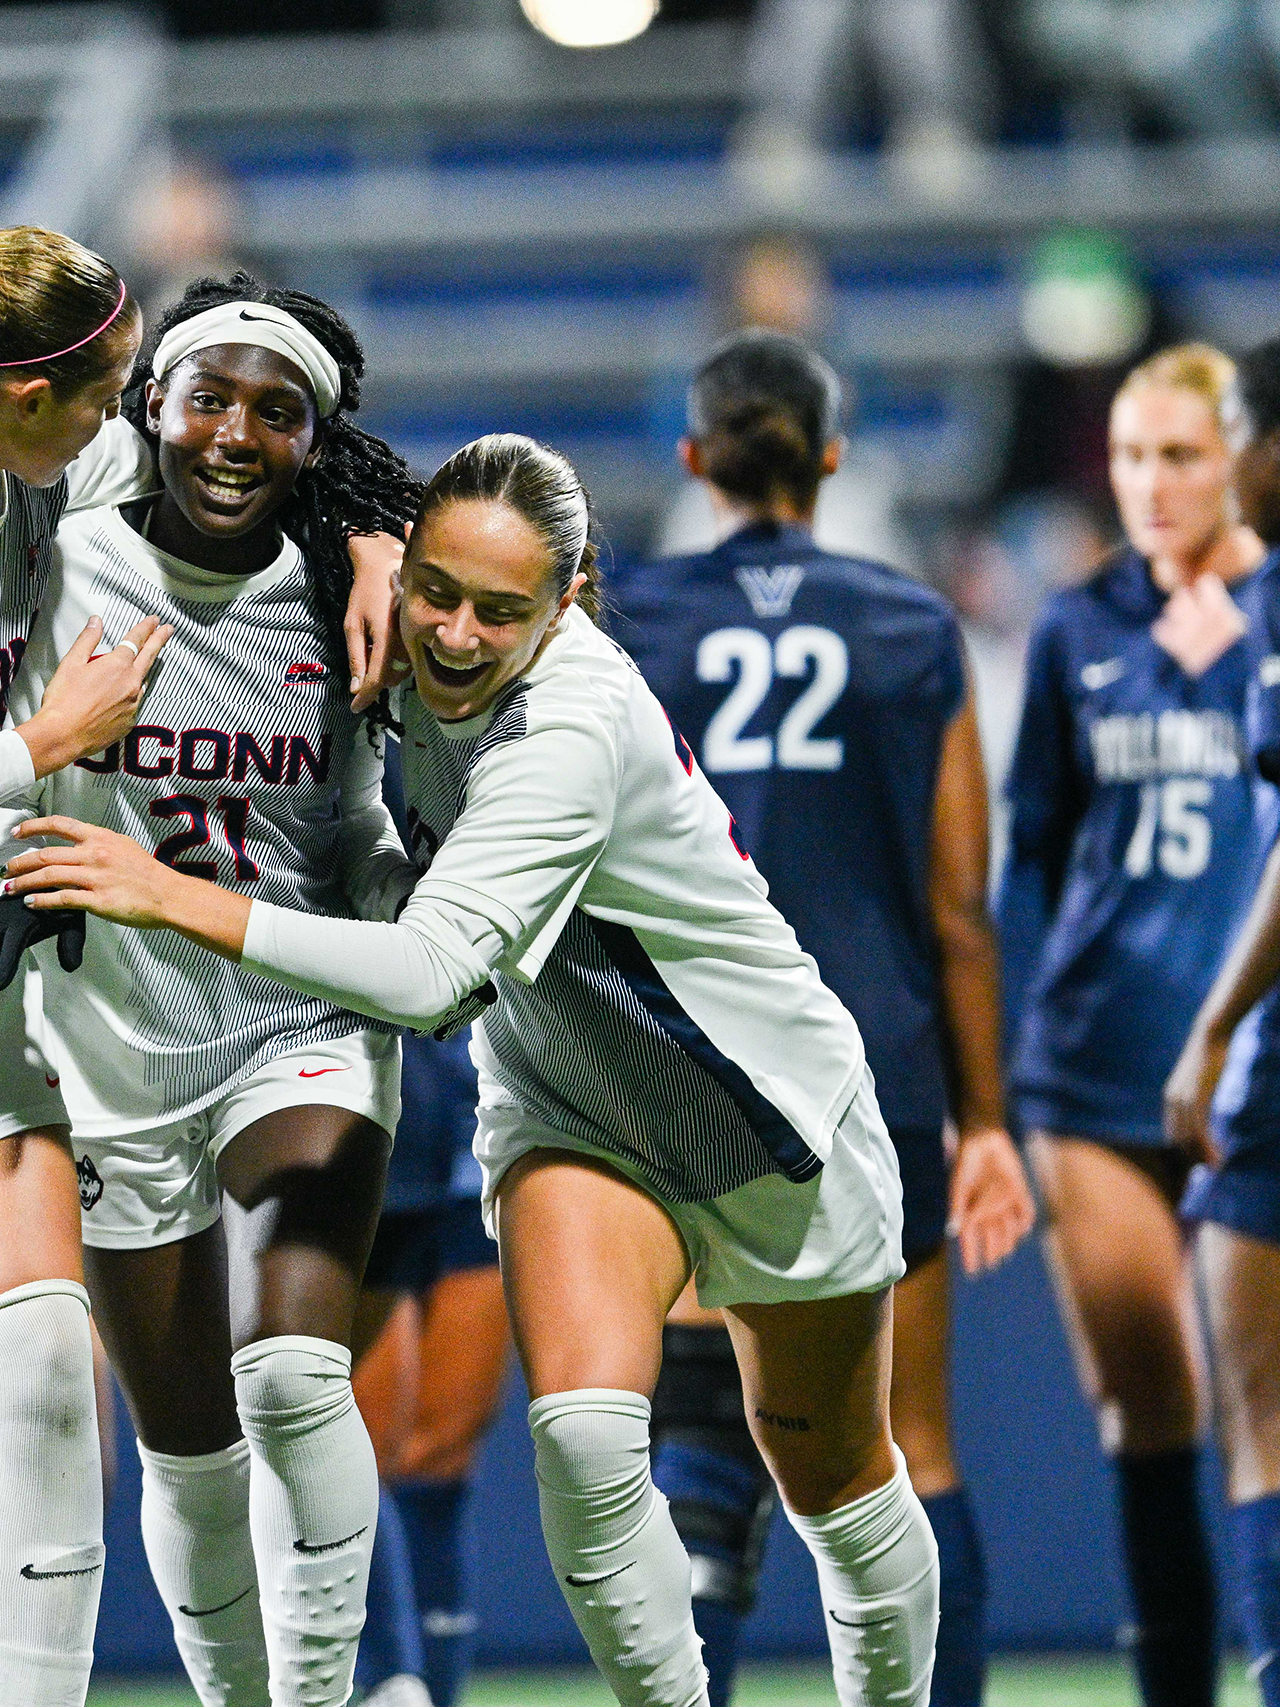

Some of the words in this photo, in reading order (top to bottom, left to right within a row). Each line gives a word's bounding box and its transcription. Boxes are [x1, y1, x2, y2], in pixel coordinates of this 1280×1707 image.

[696, 624, 849, 774] 22
[149, 793, 260, 882] 21
[1124, 778, 1214, 880] 15
